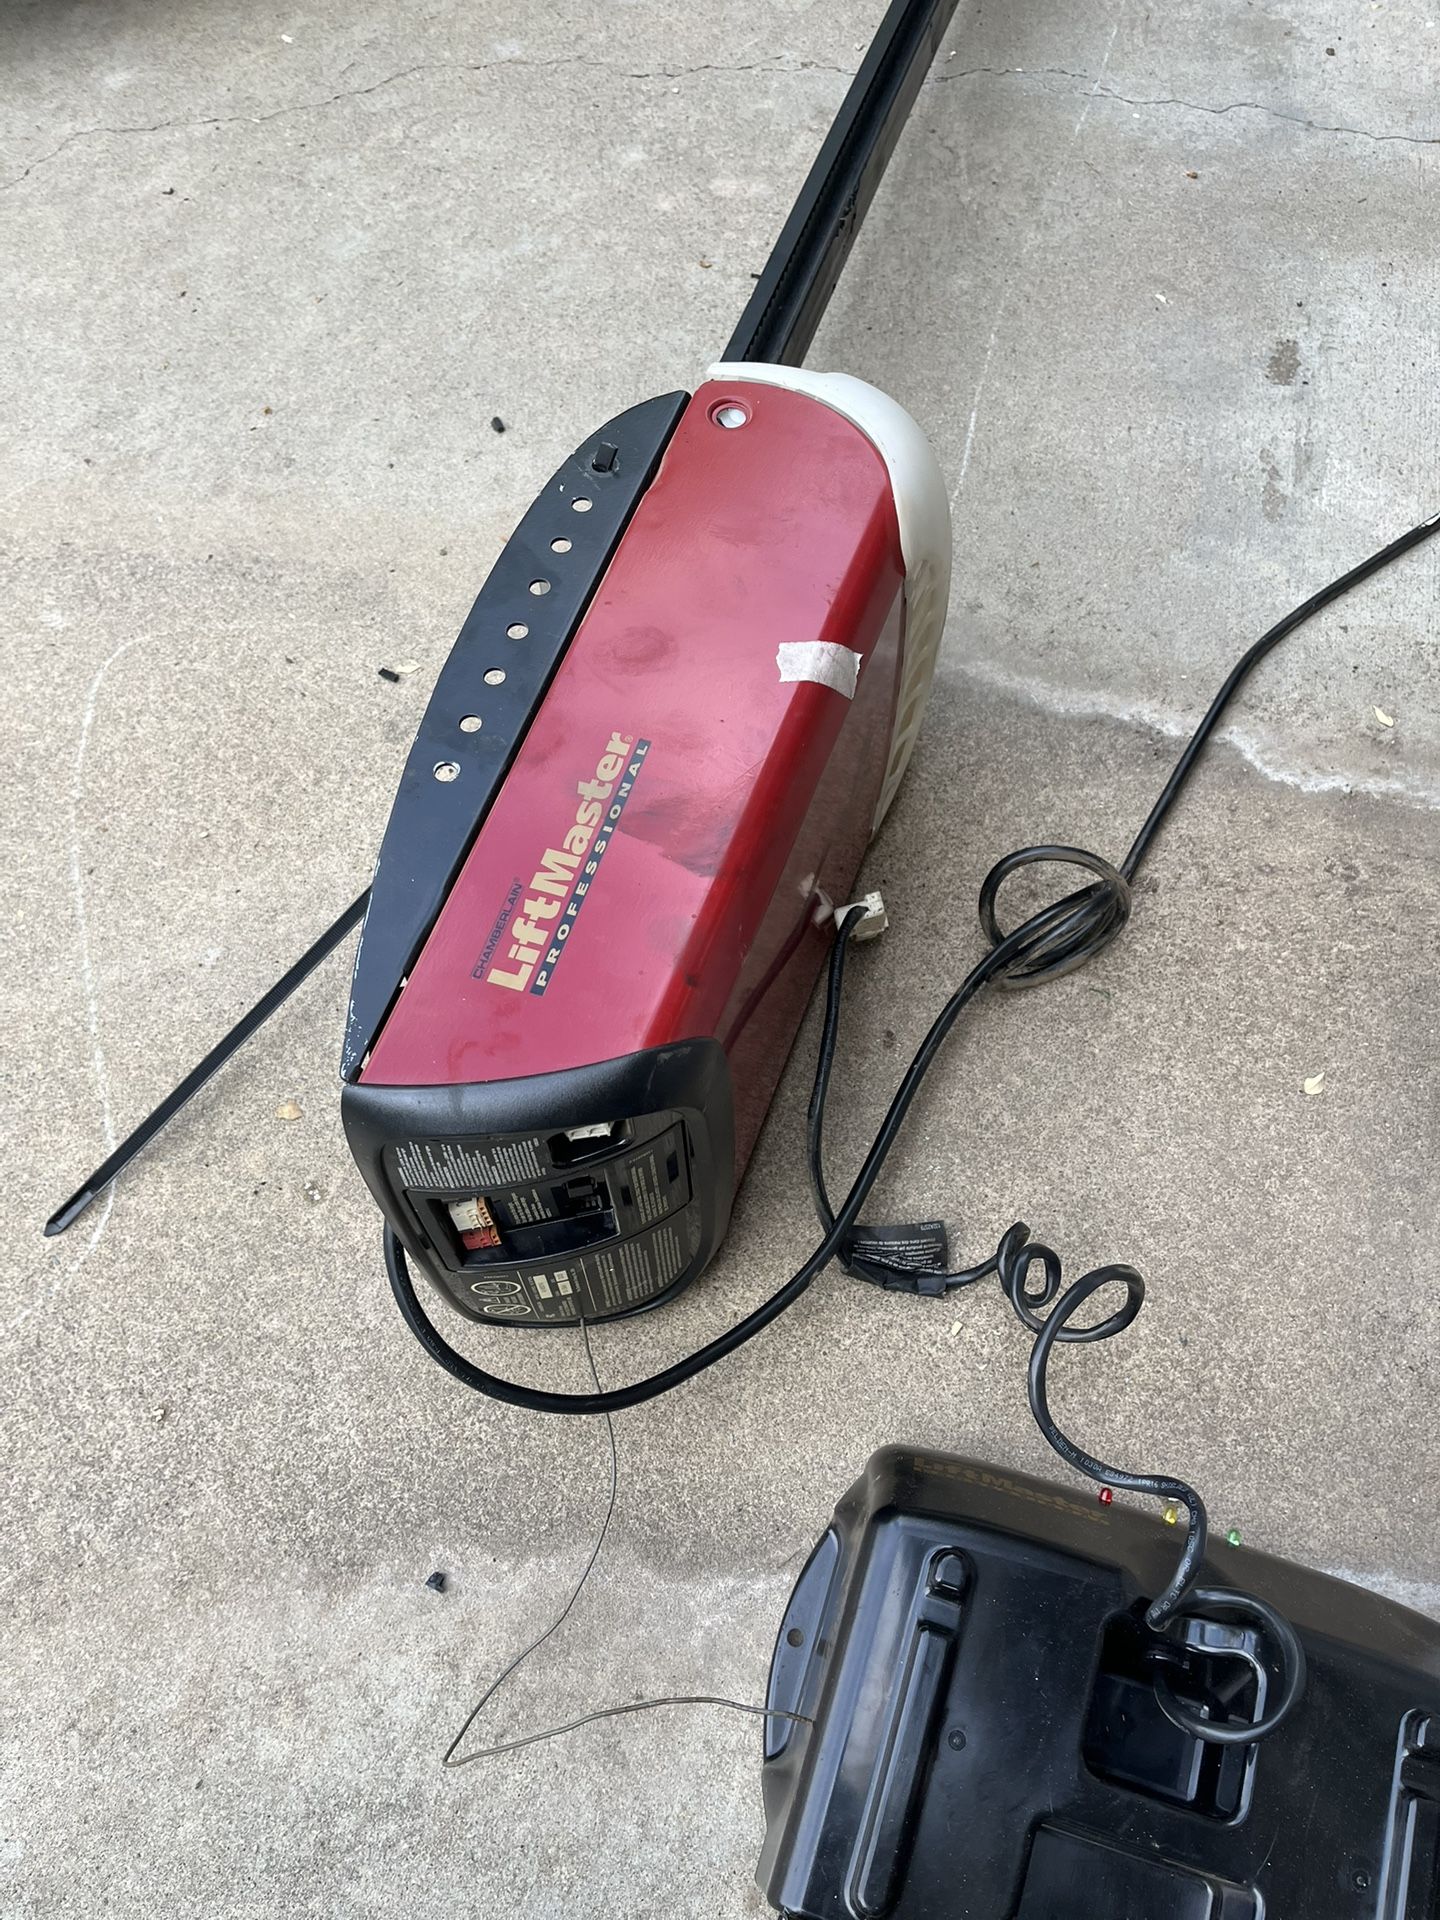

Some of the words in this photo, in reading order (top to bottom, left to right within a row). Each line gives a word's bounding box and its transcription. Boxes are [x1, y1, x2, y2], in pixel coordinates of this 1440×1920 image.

[472, 882, 523, 979] CHAMBERLAIN
[487, 731, 632, 992] LiftMaster
[535, 744, 648, 988] PROFESSIONAL
